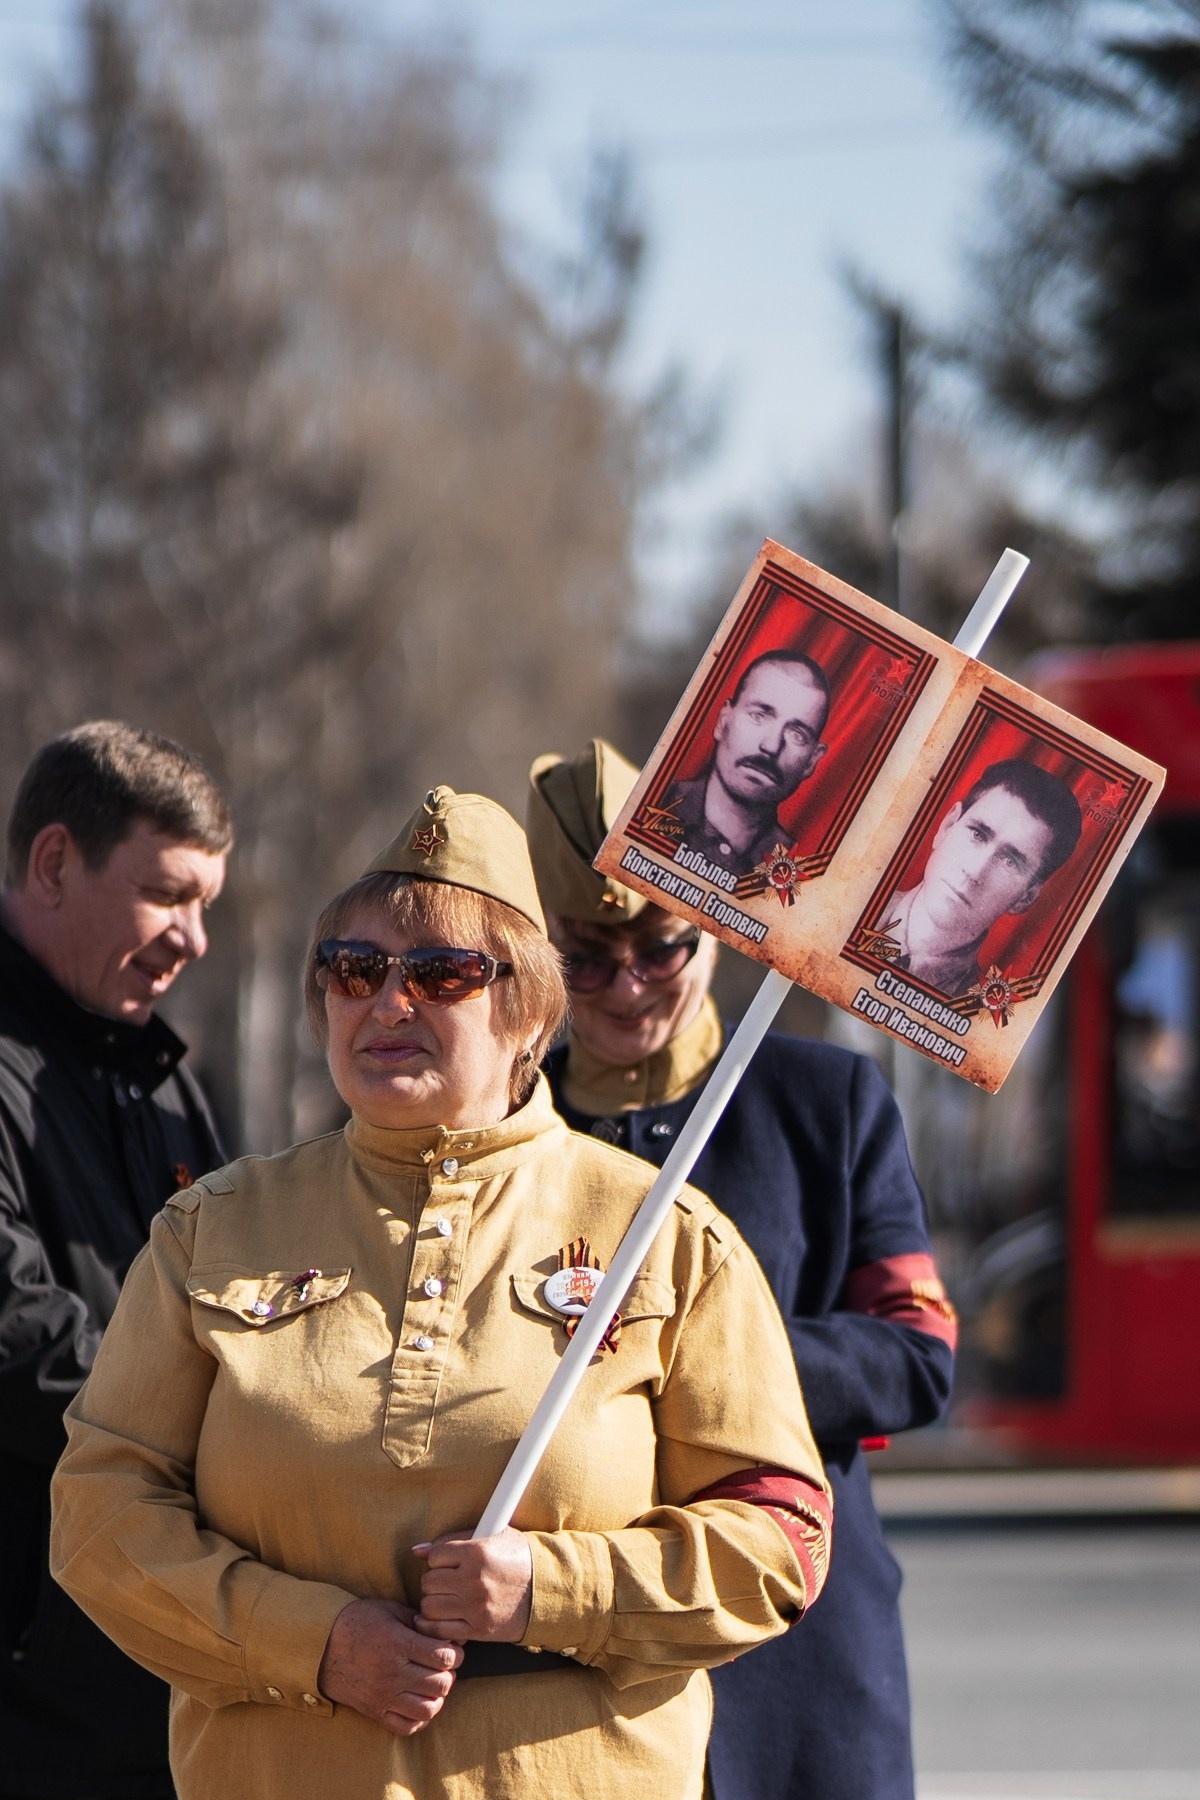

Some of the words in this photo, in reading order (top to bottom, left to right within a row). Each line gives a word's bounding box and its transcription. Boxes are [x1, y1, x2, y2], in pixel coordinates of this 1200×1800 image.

[621, 846, 705, 908] Константин
[702, 893, 769, 944] Егорович
[673, 842, 739, 893] Бобылев
[852, 988, 891, 1024] Егор
[886, 1008, 967, 1067] Иванович
[876, 970, 971, 1036] Степаненко
